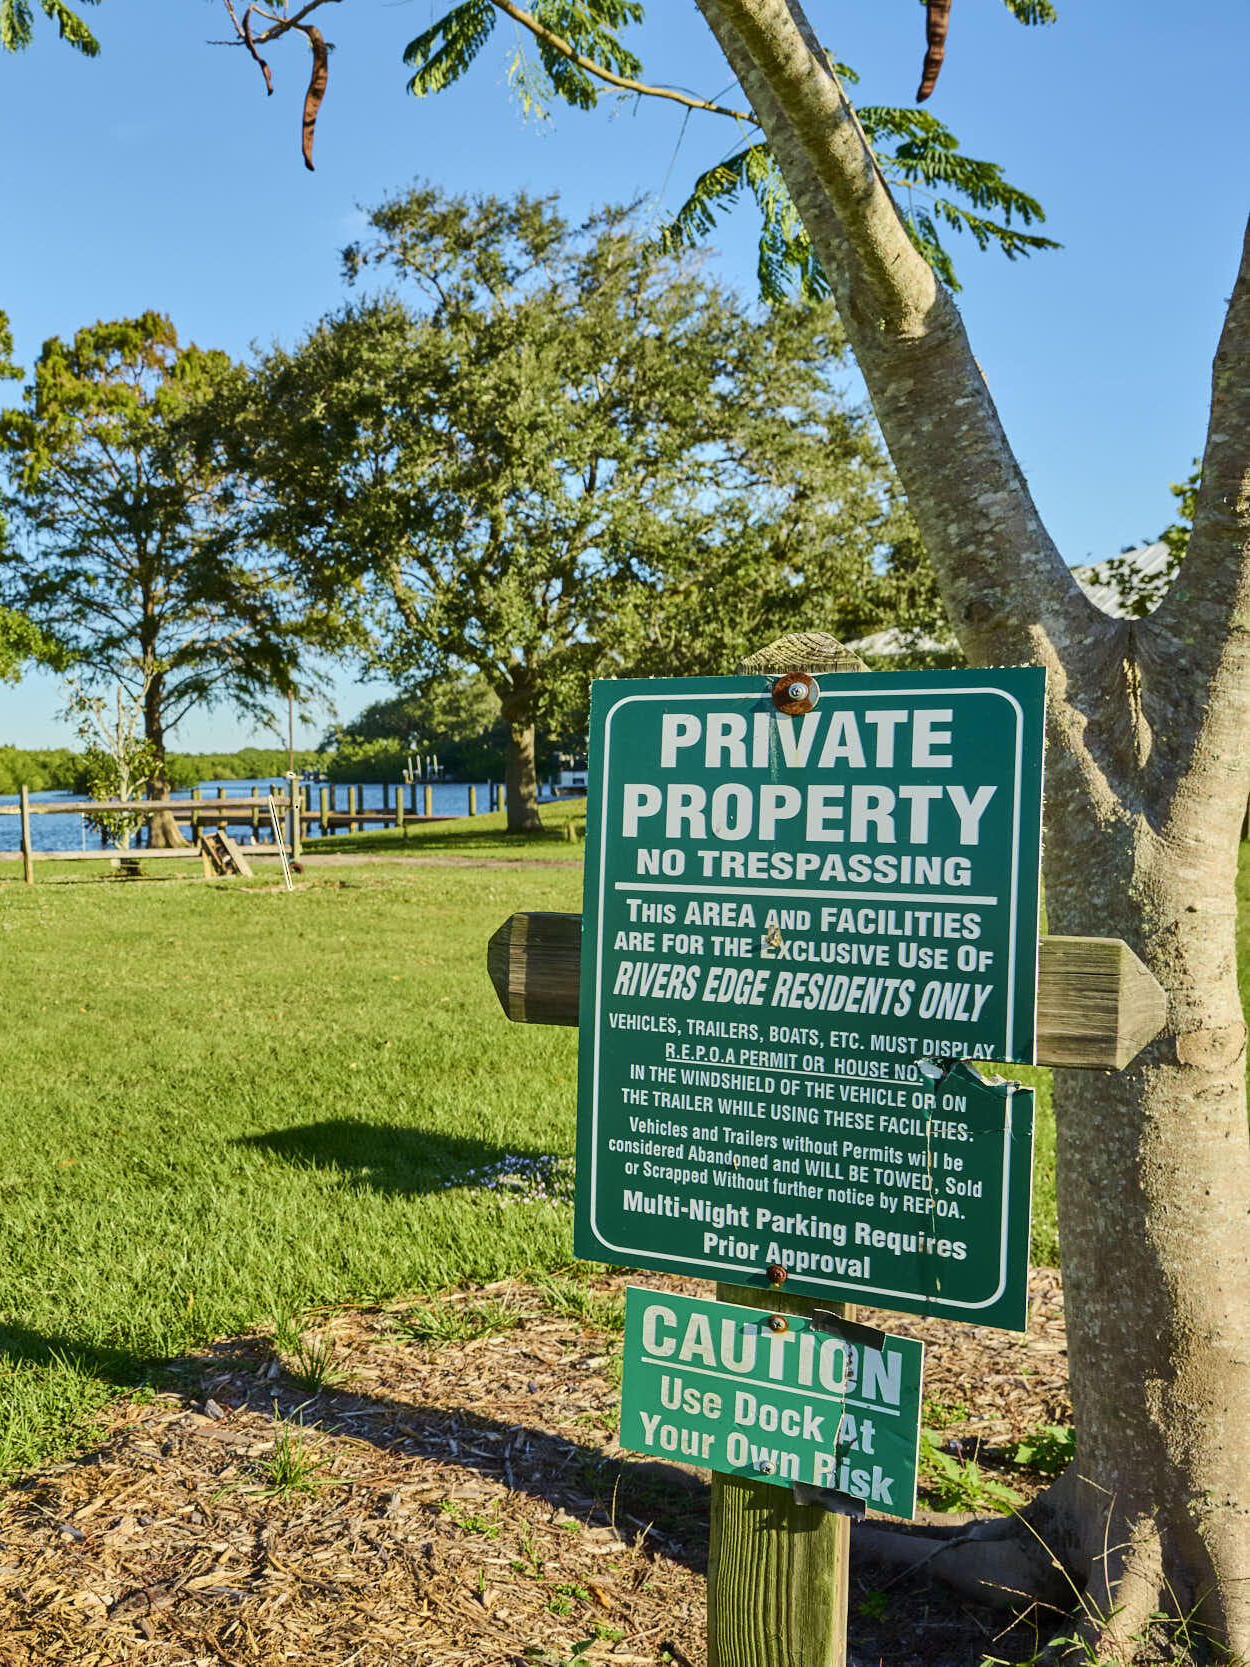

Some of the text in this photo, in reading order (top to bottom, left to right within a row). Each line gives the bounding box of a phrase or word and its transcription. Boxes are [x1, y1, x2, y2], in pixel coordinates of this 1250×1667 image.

[660, 709, 953, 768] PRIVATE
[622, 783, 998, 845] PROPERTY
[637, 848, 972, 887] NO TRESPASSING
[626, 899, 982, 940] THIS AREA AND FACILITIES
[614, 931, 994, 972] ARE FOR THE EXCLUSIVE USE OF
[613, 961, 994, 1022] RIVERS EDGE RESIDENTS ONLY
[609, 1013, 995, 1058] VEHICLES, TRAILERS, BOATS, ETC. MUST DISPLAY
[666, 1043, 924, 1082] R.E.P.O.A PERMIT OR HOUSE NO.
[622, 1088, 974, 1142] THE TRAILER WHILE USING THESE FACILITIES.
[630, 1064, 967, 1113] IN THE WINDSHIELD OF THE VEHICLE OR ON
[609, 1139, 982, 1198] considered Abandoned and WILL BE TOWED, Sold
[630, 1116, 687, 1138] Vehicles
[693, 1126, 718, 1142] and
[723, 1127, 778, 1149] Trailers
[782, 1136, 838, 1156] without
[843, 1141, 903, 1164] Permits
[943, 1153, 963, 1171] be
[625, 1161, 966, 1220] or Scrapped Without further notice by REPOA.
[623, 1189, 967, 1260] Multi-Night Parking Requires
[704, 1232, 870, 1279] Prior Approval
[642, 1305, 903, 1406] CAUTION
[660, 1375, 876, 1455] Use Dock At
[639, 1411, 895, 1505] Your Own Risk
